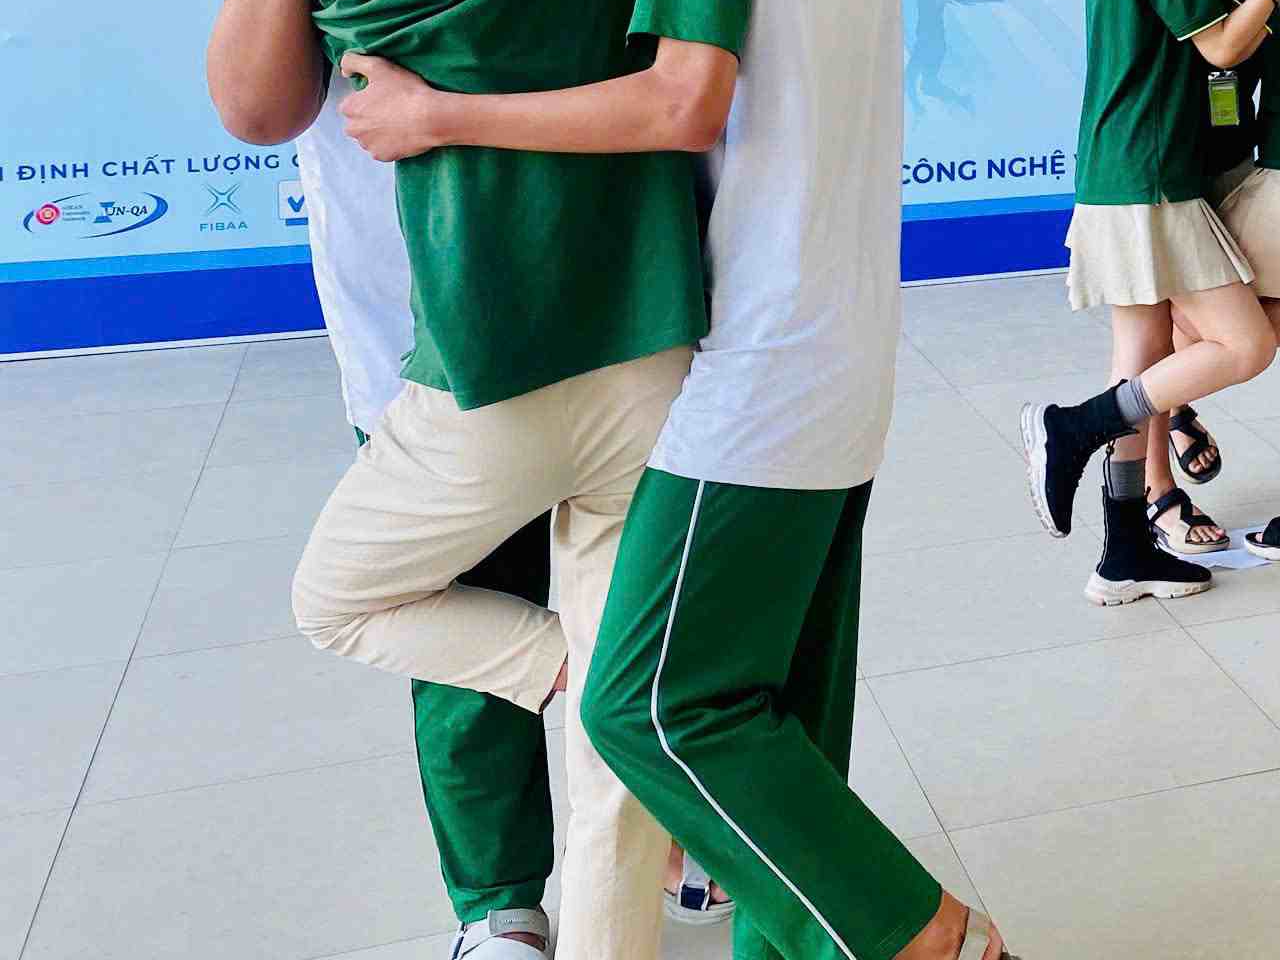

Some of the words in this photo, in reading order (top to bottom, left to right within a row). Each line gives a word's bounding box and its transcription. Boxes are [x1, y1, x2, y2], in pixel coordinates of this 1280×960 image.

[16, 163, 89, 184] ĐỊNH
[102, 154, 175, 177] CHẤT
[187, 153, 280, 175] LƯỢNG
[987, 149, 1066, 181] NGHỆ
[199, 221, 249, 232] FIBAA
